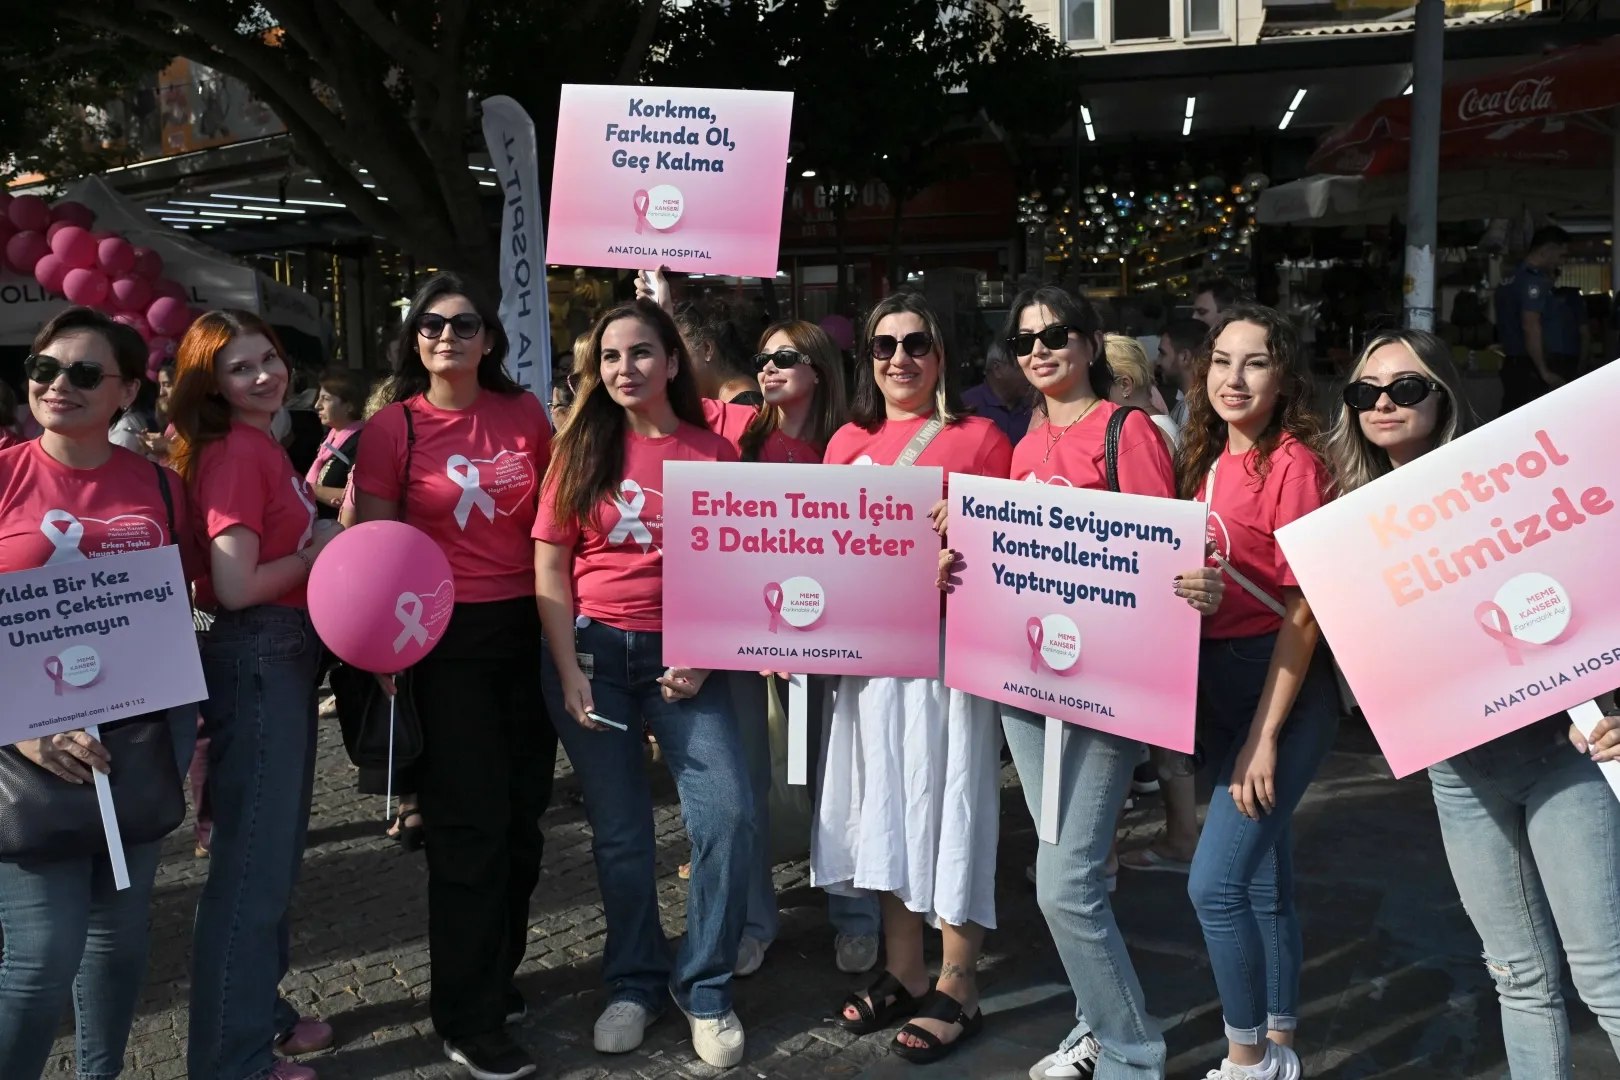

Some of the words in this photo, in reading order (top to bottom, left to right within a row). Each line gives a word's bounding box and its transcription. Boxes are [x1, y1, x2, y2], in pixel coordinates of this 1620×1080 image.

[628, 98, 716, 124] Korkma,
[1458, 76, 1555, 121] Coca-Cola
[605, 123, 699, 146] Farkında
[705, 127, 736, 151] Ol,
[612, 149, 650, 173] Geç
[655, 150, 724, 172] Kalma
[607, 245, 658, 256] ANATOLIA
[661, 248, 712, 259] HOSPITAL
[1367, 429, 1570, 549] Kontrol
[691, 490, 777, 518] Erken
[784, 492, 850, 519] Tanı
[859, 487, 914, 526] İçin
[961, 495, 1043, 527] Kendimi
[1048, 506, 1181, 550] Seviyorum,
[690, 526, 709, 552] 3
[719, 526, 824, 554] Dakika
[831, 529, 915, 556] Yeter
[992, 531, 1139, 574] Kontrollerimi
[1382, 486, 1614, 607] Elimizde
[52, 576, 87, 594] Bir
[91, 571, 130, 588] Kez
[992, 562, 1137, 609] Yaptırıyorum
[1526, 586, 1556, 605] MEME
[56, 580, 174, 619] Çektirmeyi
[1519, 594, 1561, 620] KANSERİ
[8, 615, 130, 647] Unutmayın
[1057, 632, 1076, 642] MEME
[737, 646, 799, 656] ANATOLIA
[802, 648, 863, 659] HOSPITAL
[1003, 681, 1056, 702] ANATOLIA
[1059, 694, 1115, 717] HOSPITAL
[1484, 672, 1572, 717] ANATOLIA
[28, 706, 105, 728] anatoliahospital.com
[110, 703, 124, 711] 444
[132, 697, 145, 706] 112
